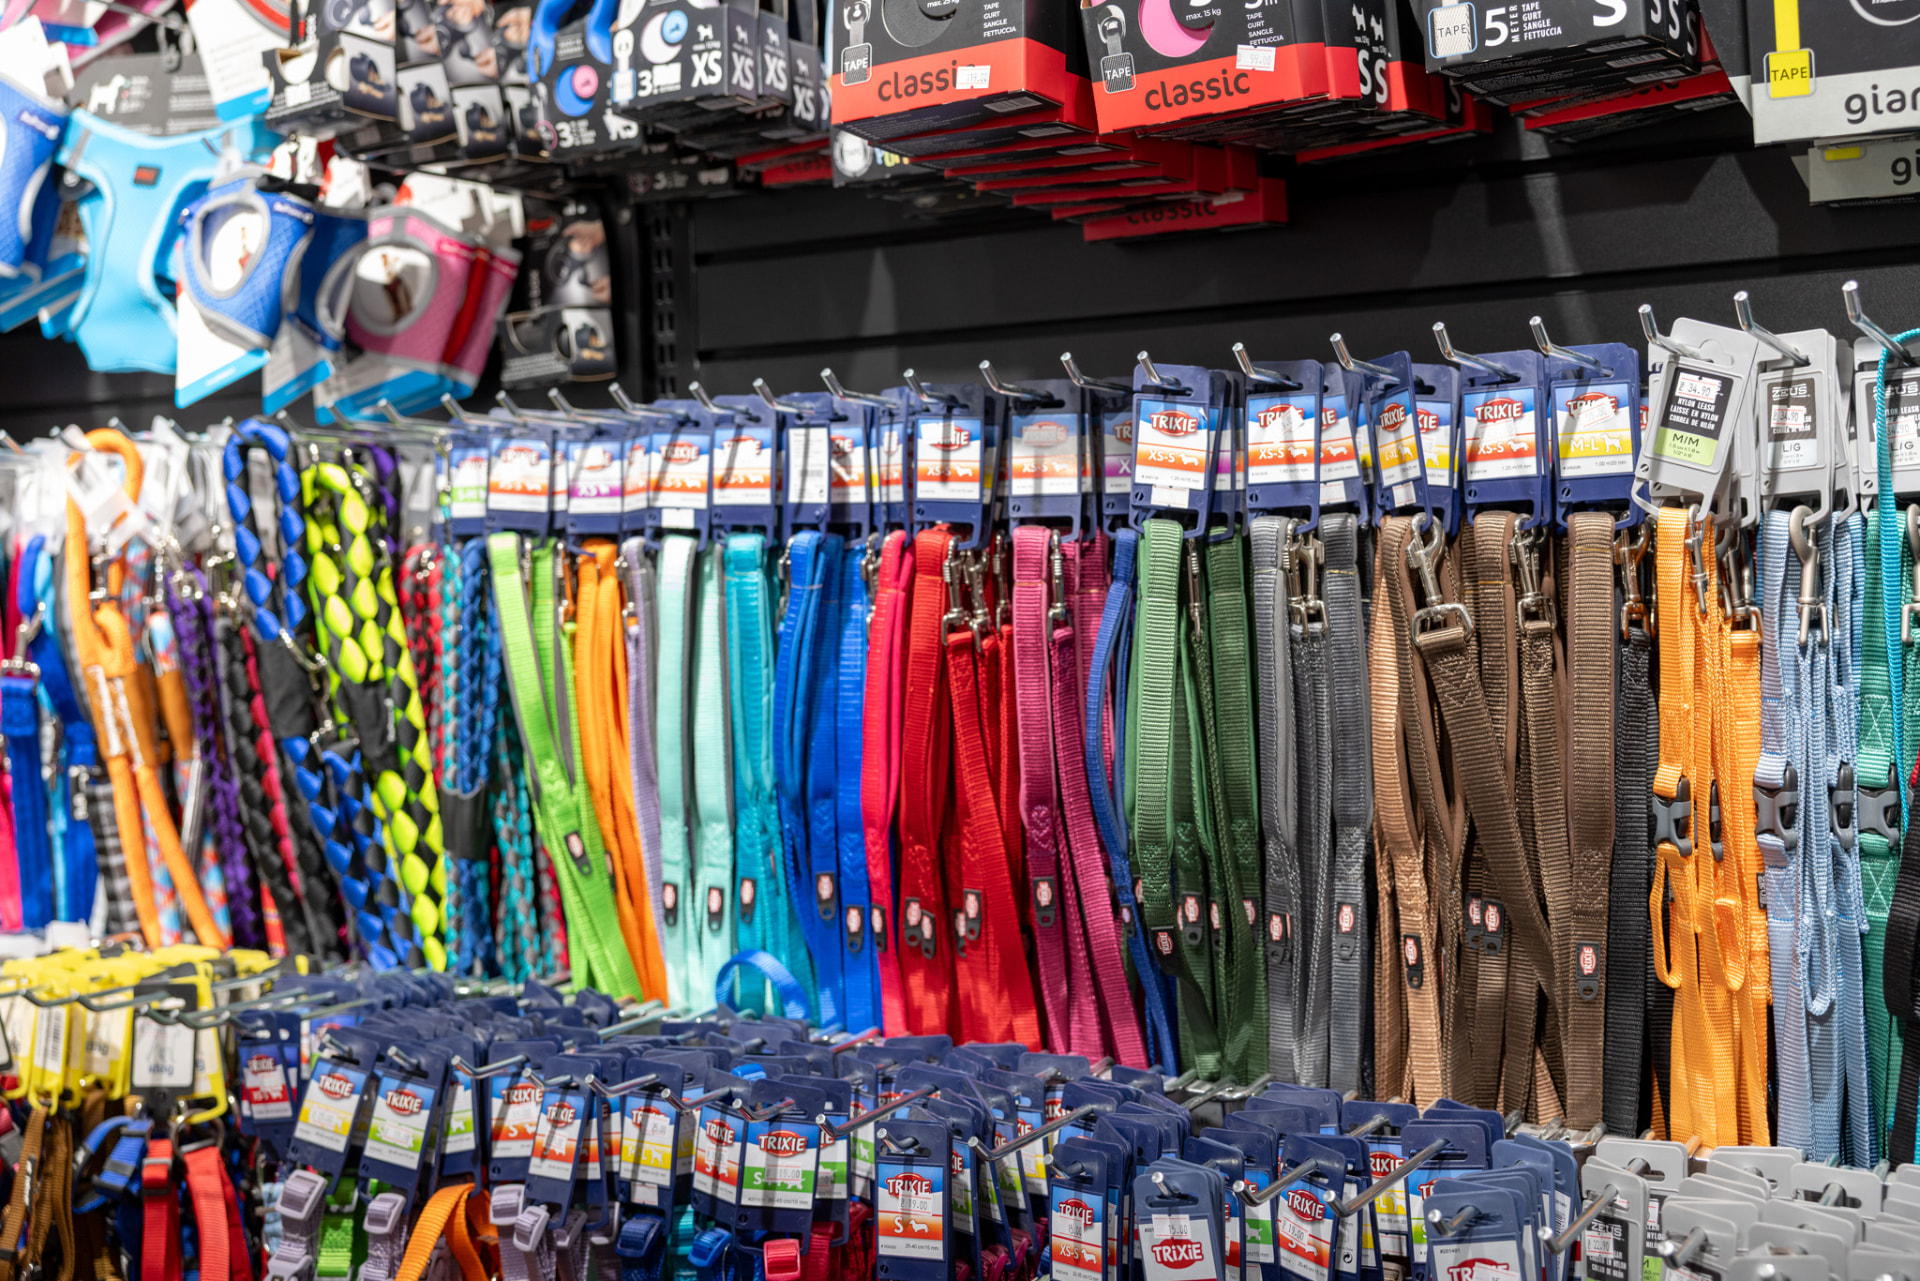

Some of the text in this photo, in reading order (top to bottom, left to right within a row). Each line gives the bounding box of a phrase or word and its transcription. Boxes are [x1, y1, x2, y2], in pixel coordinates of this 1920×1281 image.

[1186, 8, 1222, 21] max. 15 kg
[1521, 2, 1540, 12] TAPE
[984, 11, 1000, 20] GURT
[1246, 12, 1263, 20] TAPE
[1522, 11, 1542, 21] GURT
[1668, 0, 1680, 39] S
[983, 26, 1017, 38] FETTUCCIA
[984, 19, 1008, 29] SANGLE
[1247, 21, 1264, 29] GURT
[1437, 24, 1467, 38] TAPE
[1484, 7, 1509, 47] 5
[1510, 5, 1520, 43] METER
[1523, 19, 1551, 31] SANGLE
[1248, 28, 1274, 38] SANGLE
[1249, 35, 1284, 46] FETTUCCIA
[1524, 27, 1562, 41] FETTUCCIA
[1686, 10, 1697, 56] S
[690, 50, 722, 88] XS
[731, 51, 755, 91] XS
[763, 52, 788, 92] XS
[844, 57, 869, 72] TAPE
[1358, 49, 1372, 95] S
[877, 60, 976, 102] classi
[1105, 66, 1132, 81] TAPE
[1374, 59, 1388, 104] S
[1770, 66, 1809, 82] TAPE
[636, 69, 653, 97] 3
[1144, 69, 1251, 111] classic
[792, 84, 816, 121] XS
[555, 121, 575, 148] 3
[1687, 383, 1711, 398] 34.90
[1772, 383, 1808, 401] ZEUS
[1475, 402, 1522, 421] TRIXIE
[1677, 397, 1715, 412] NYLON LEASH
[1900, 405, 1920, 415] LEASH
[1380, 405, 1405, 428] TRIXIE
[1669, 414, 1690, 425] CORREA
[1691, 419, 1699, 427] DE
[1670, 404, 1719, 422] LAISSE EN NYLON
[1150, 413, 1198, 433] TRIXIE
[1477, 441, 1504, 455] XS-S
[1570, 437, 1599, 453] M-L
[1672, 433, 1700, 448] M/M
[1782, 442, 1801, 453] L/G
[1891, 441, 1914, 452] L/G
[1147, 449, 1176, 463] XS-S
[1258, 447, 1285, 460] XS-S
[1022, 462, 1049, 473] XS-S
[319, 1074, 354, 1097] TRIXIE
[386, 1090, 423, 1113] TRIXIE
[502, 1087, 544, 1103] TRIXIE
[547, 1105, 576, 1123] TRIXIE
[705, 1121, 735, 1144] TRIXIE
[758, 1134, 807, 1152] TRIXIE
[1369, 1157, 1404, 1173] RIXIE
[886, 1178, 931, 1196] TRIXIE
[908, 1199, 928, 1211] 19.00
[1287, 1191, 1324, 1220] TRIXIE
[1059, 1203, 1093, 1225] TRIXIE
[893, 1216, 904, 1234] S
[1168, 1224, 1188, 1235] 15.00
[1288, 1223, 1305, 1242] 19.00
[1060, 1244, 1079, 1260] XS-S
